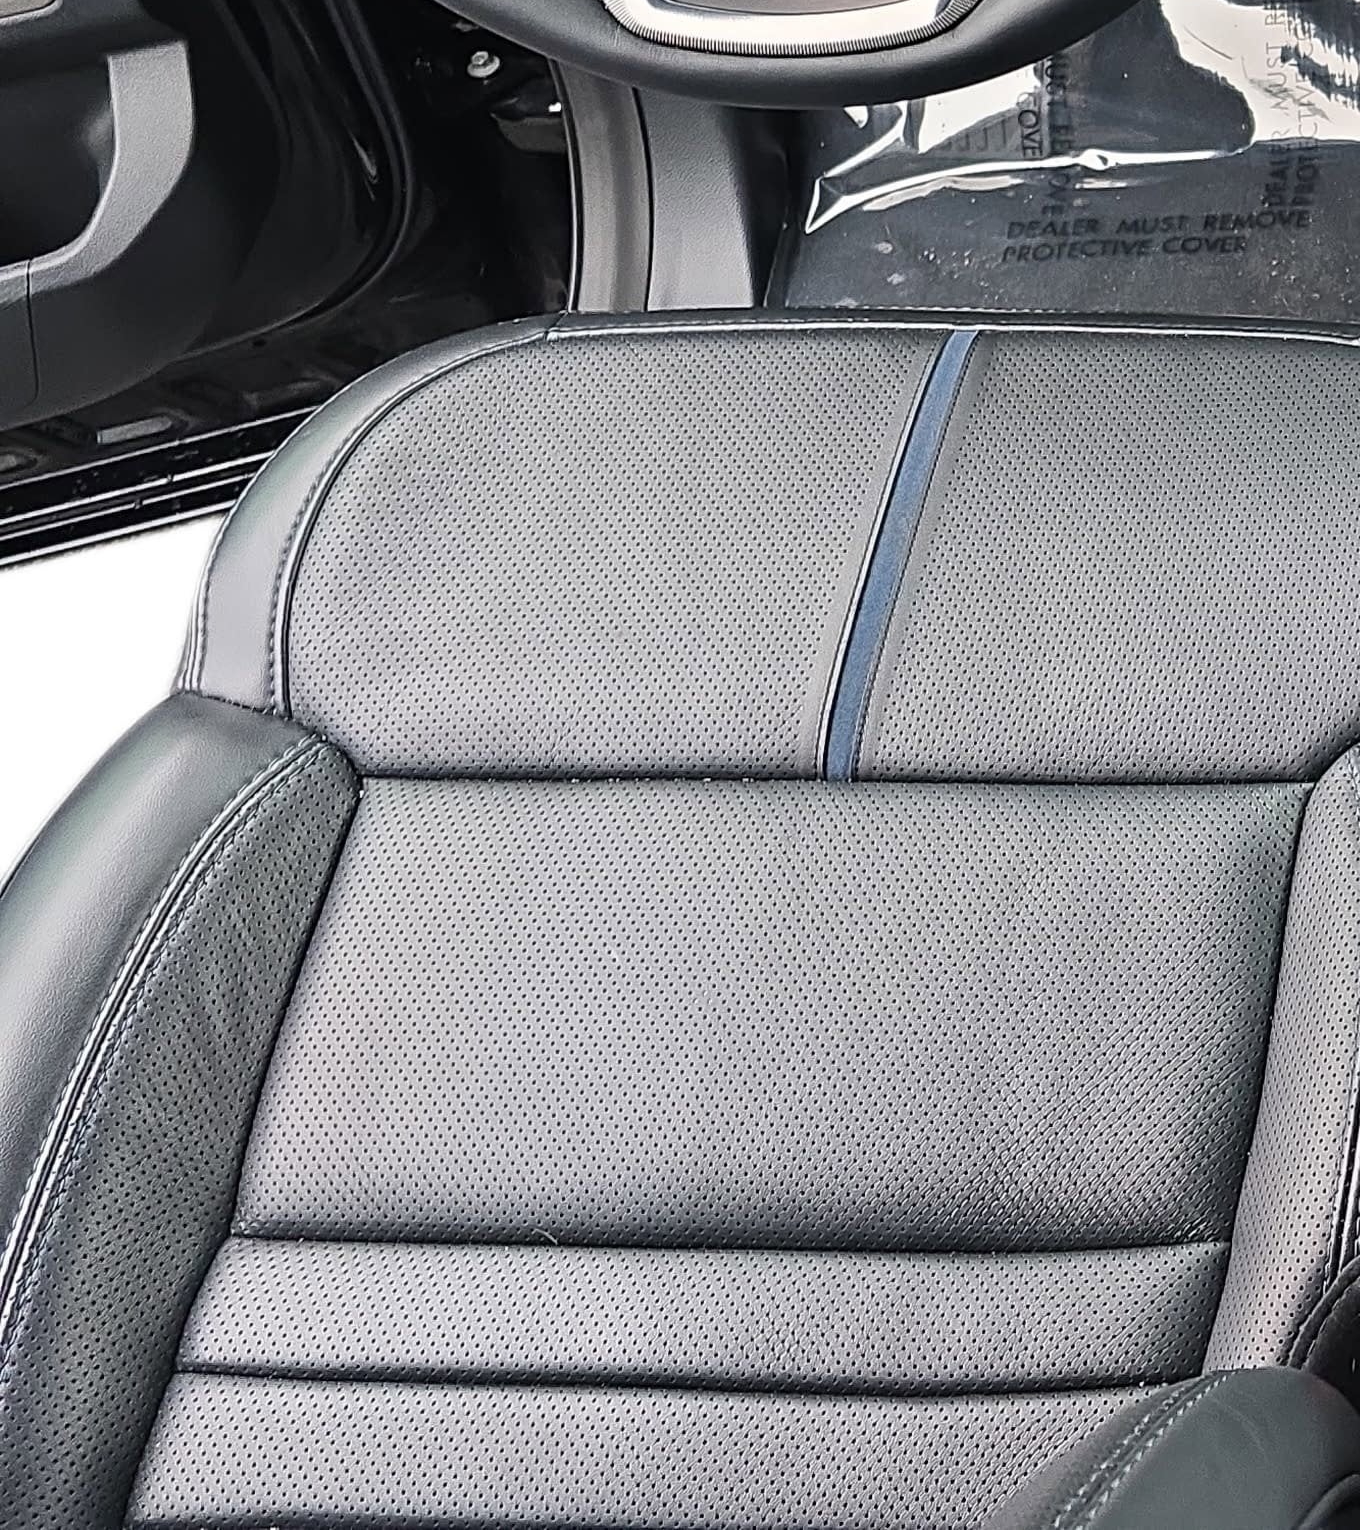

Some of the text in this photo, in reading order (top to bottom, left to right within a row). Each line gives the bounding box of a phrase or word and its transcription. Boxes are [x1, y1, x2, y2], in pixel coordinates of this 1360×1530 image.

[1006, 218, 1100, 241] DEALER
[1116, 215, 1186, 236] MUST
[1001, 234, 1247, 263] PROTECTIVE COVER
